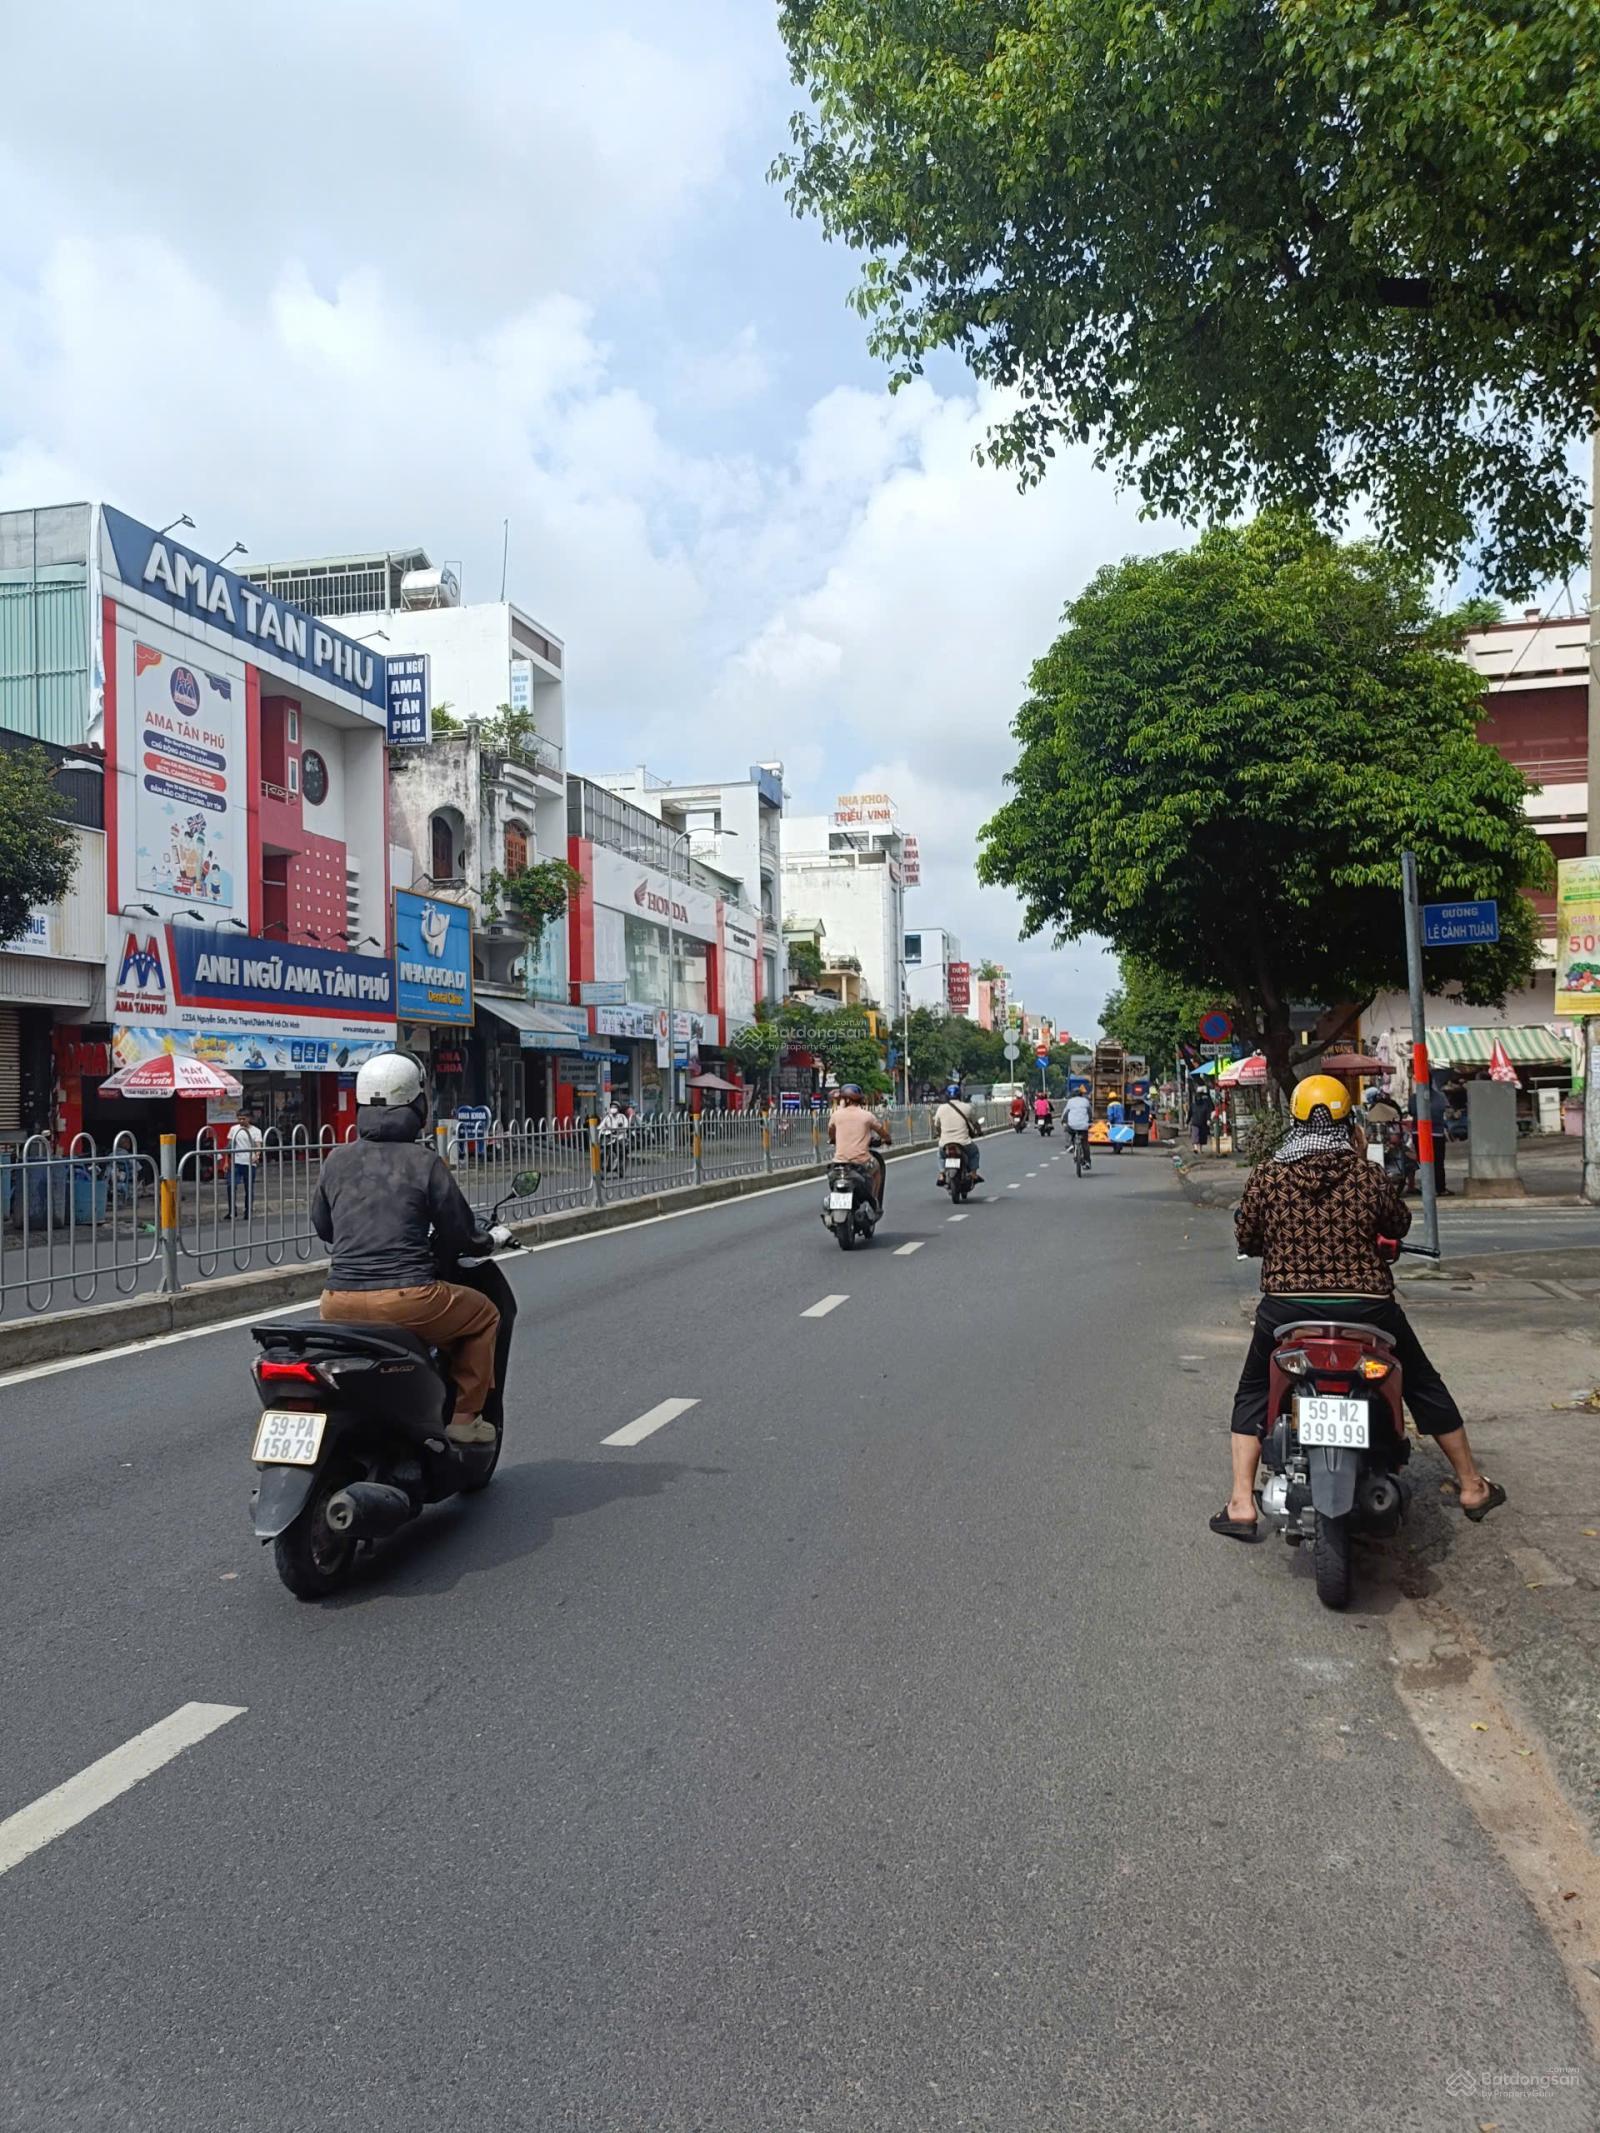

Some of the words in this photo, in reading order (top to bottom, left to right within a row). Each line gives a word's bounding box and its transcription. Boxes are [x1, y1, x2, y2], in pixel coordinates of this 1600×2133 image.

[143, 541, 236, 624] AMA
[241, 588, 307, 658] TAN
[314, 628, 374, 690] PHU
[388, 662, 404, 675] ANH
[390, 679, 422, 695] AMA
[393, 698, 420, 715] TÂN
[145, 711, 174, 732] AMA
[177, 721, 200, 741] TÂN
[203, 731, 225, 749] PHÚ
[393, 717, 421, 735] PHÚ
[867, 810, 891, 820] VINH
[1442, 905, 1479, 919] ĐƯỜNG
[1427, 923, 1440, 940] LÊ
[1441, 921, 1467, 939] CẢNH
[1569, 934, 1600, 954] 50
[195, 954, 240, 985] ANH
[243, 956, 283, 990] NGỮ
[284, 965, 323, 995] AMA
[323, 965, 357, 998] TÂN
[358, 971, 390, 1001] PHÚ
[400, 961, 425, 985] NHA
[115, 1001, 133, 1013] AMA
[269, 1416, 315, 1438] 59-PA
[1303, 1422, 1365, 1445] 399.99
[262, 1438, 315, 1461] 158.79
